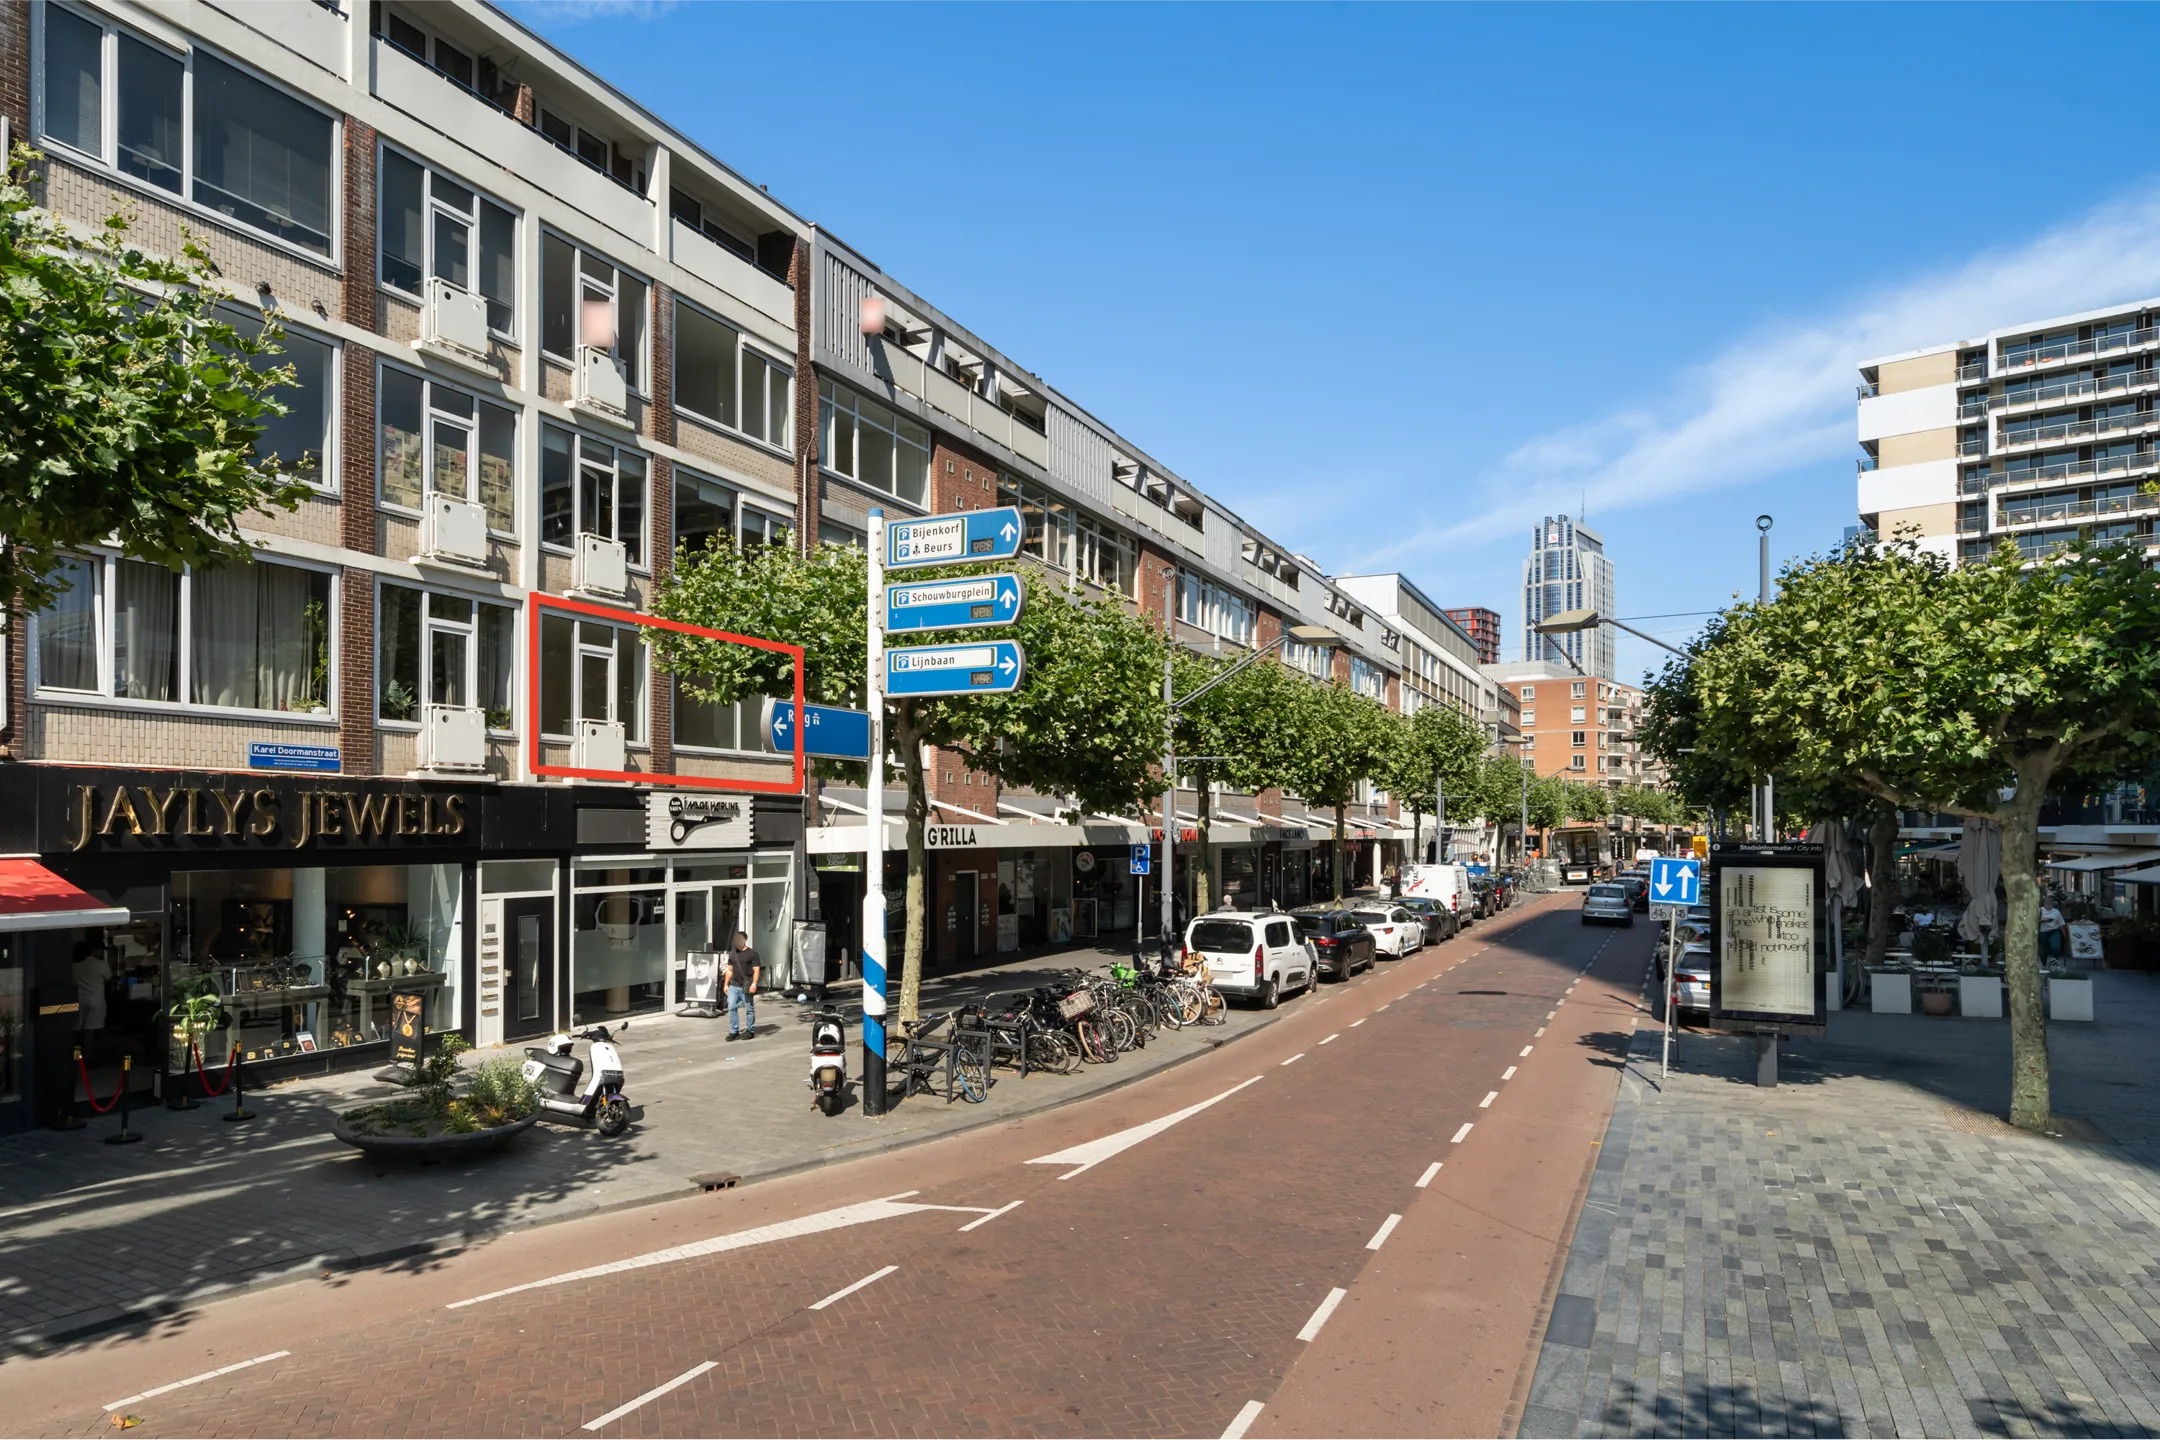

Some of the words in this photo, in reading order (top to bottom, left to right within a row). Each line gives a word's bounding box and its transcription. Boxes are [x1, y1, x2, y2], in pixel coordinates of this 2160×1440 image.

[913, 524, 960, 539] Bijenkorf
[924, 543, 952, 553] Beurs
[912, 587, 990, 602] Schouwburgplein
[912, 656, 955, 668] Lijnbaan
[788, 709, 810, 727] Rg
[253, 745, 276, 754] Karel
[278, 747, 337, 758] Doormanstraat
[710, 801, 739, 812] HAIRLINE
[73, 785, 275, 852] JAYLYS
[295, 790, 464, 849] JEWELS
[928, 827, 976, 846] G'RILLA
[1280, 829, 1304, 839] FACELAND
[1134, 846, 1146, 862] P
[1769, 904, 1777, 913] is
[1777, 909, 1806, 918] some
[1733, 919, 1752, 927] one
[1761, 944, 1778, 952] not
